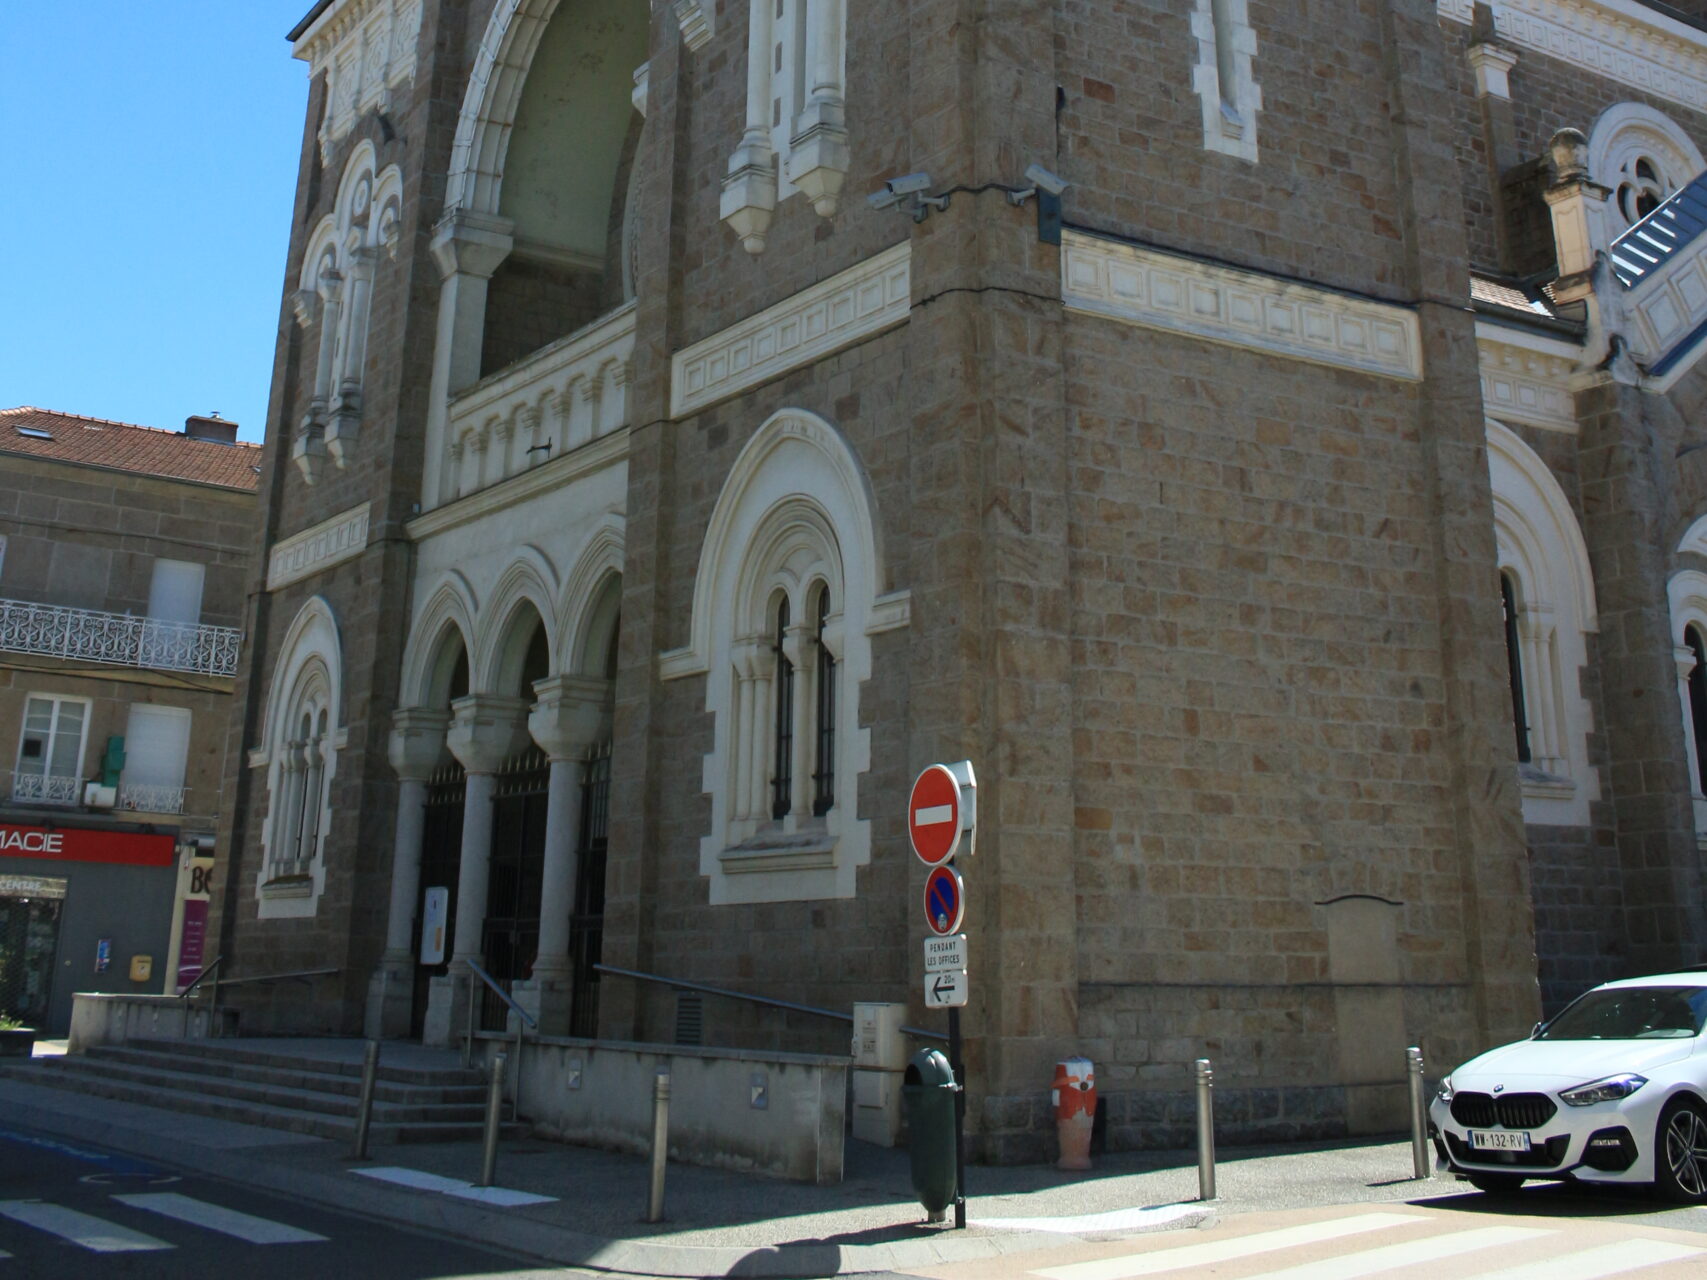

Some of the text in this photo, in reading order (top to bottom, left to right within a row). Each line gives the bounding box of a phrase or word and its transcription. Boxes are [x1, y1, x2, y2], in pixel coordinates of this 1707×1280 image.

[929, 941, 956, 953] PENDANT
[927, 955, 960, 966] LES OFFICES
